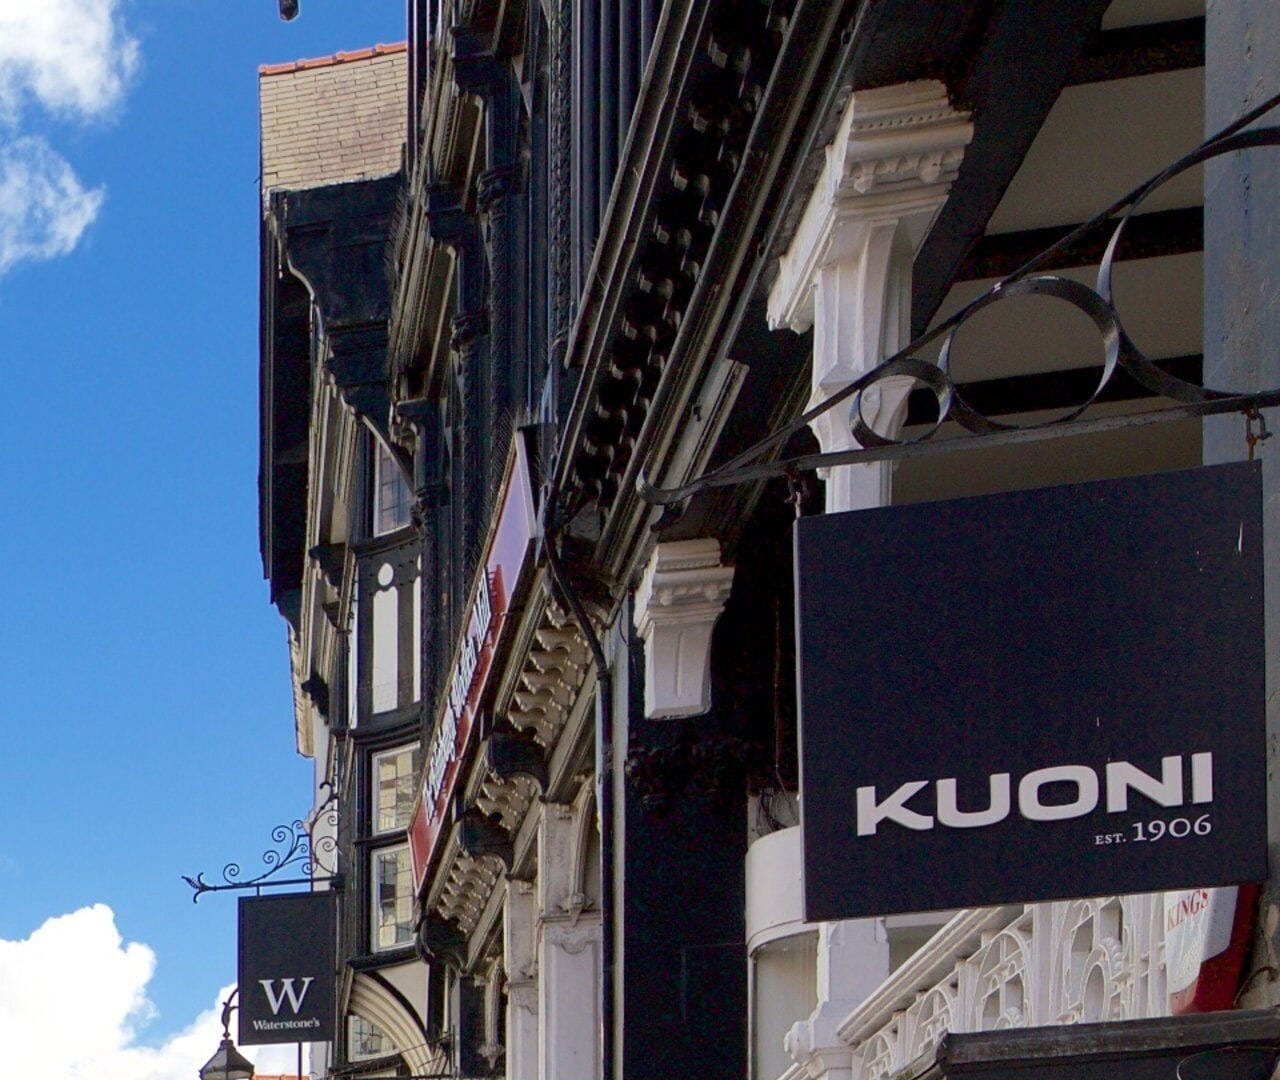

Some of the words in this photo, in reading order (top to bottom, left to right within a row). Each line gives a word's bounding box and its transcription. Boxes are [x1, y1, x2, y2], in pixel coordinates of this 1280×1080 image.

[856, 752, 1213, 837] KUONI
[1095, 831, 1127, 846] EST.
[1132, 813, 1212, 842] 1906
[259, 976, 315, 1015] W
[253, 1017, 321, 1031] Waterstone's
